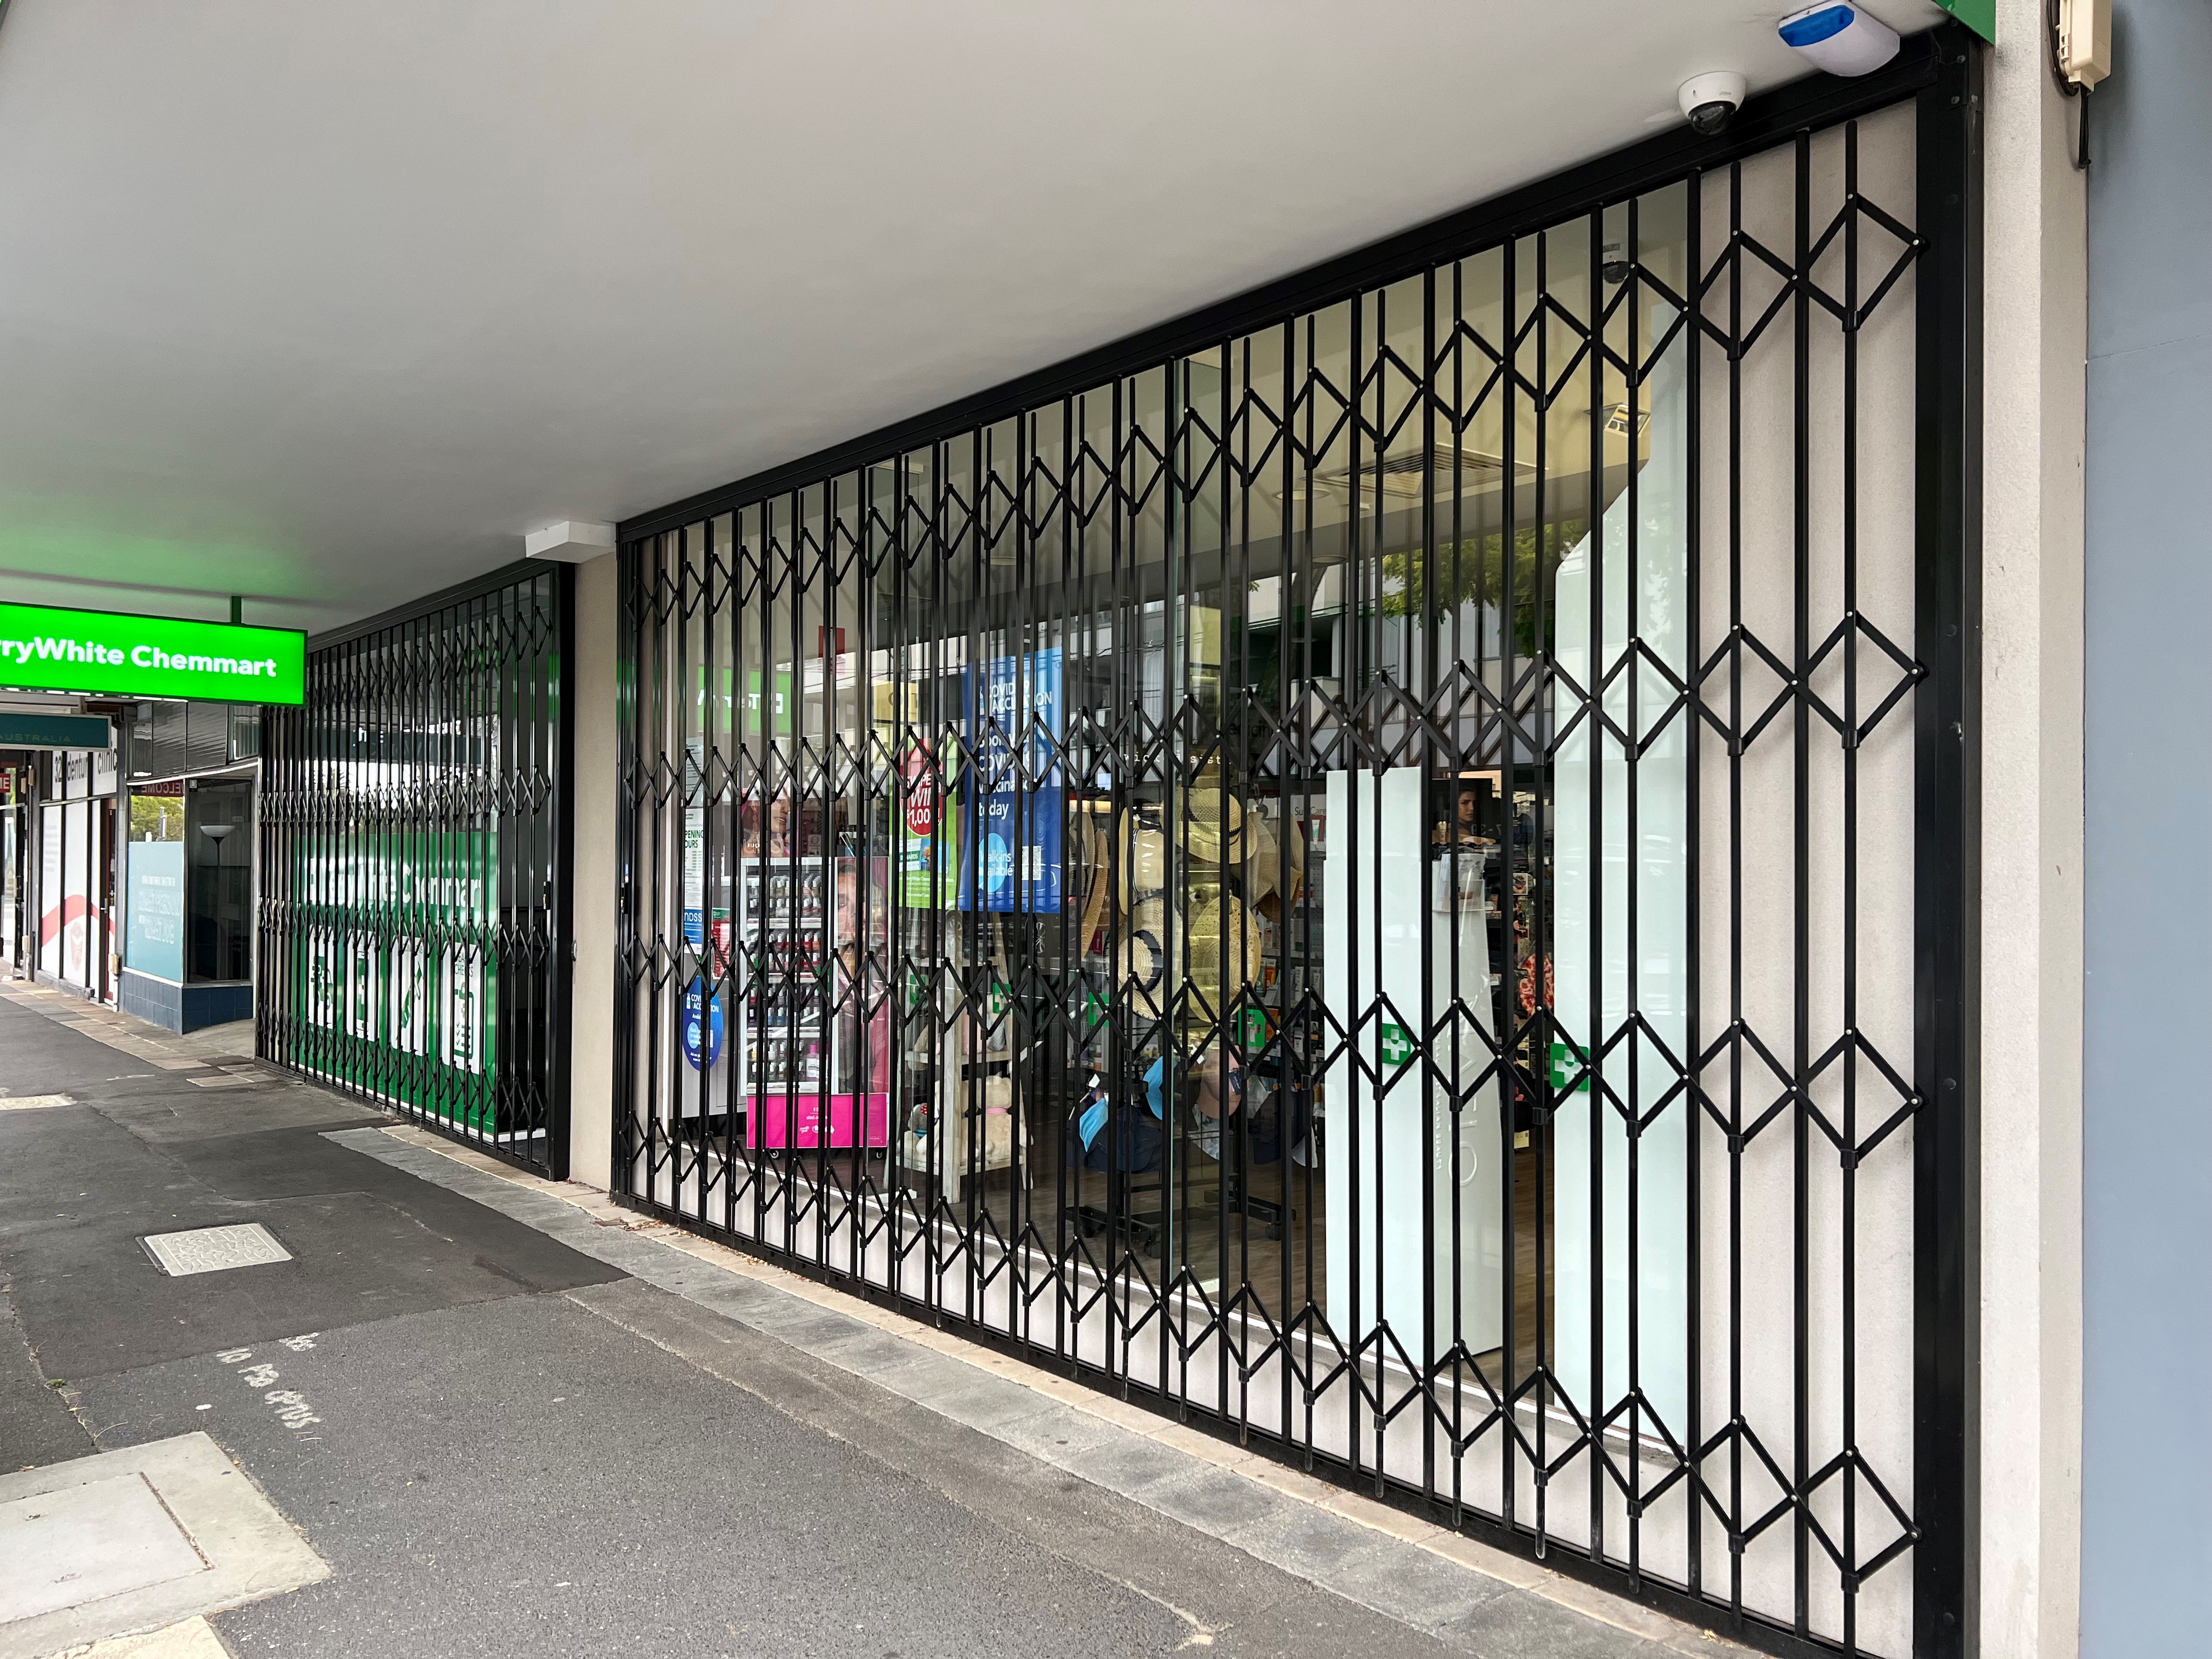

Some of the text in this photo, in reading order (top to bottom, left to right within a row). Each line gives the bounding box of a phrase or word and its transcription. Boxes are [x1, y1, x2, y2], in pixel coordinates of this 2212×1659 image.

[0, 636, 277, 678] ryWhite Chemmart
[67, 753, 88, 781] dentur
[979, 799, 1009, 820] tday
[685, 830, 704, 839] PENIN
[685, 839, 698, 849] OURS
[979, 862, 1013, 877] aailable
